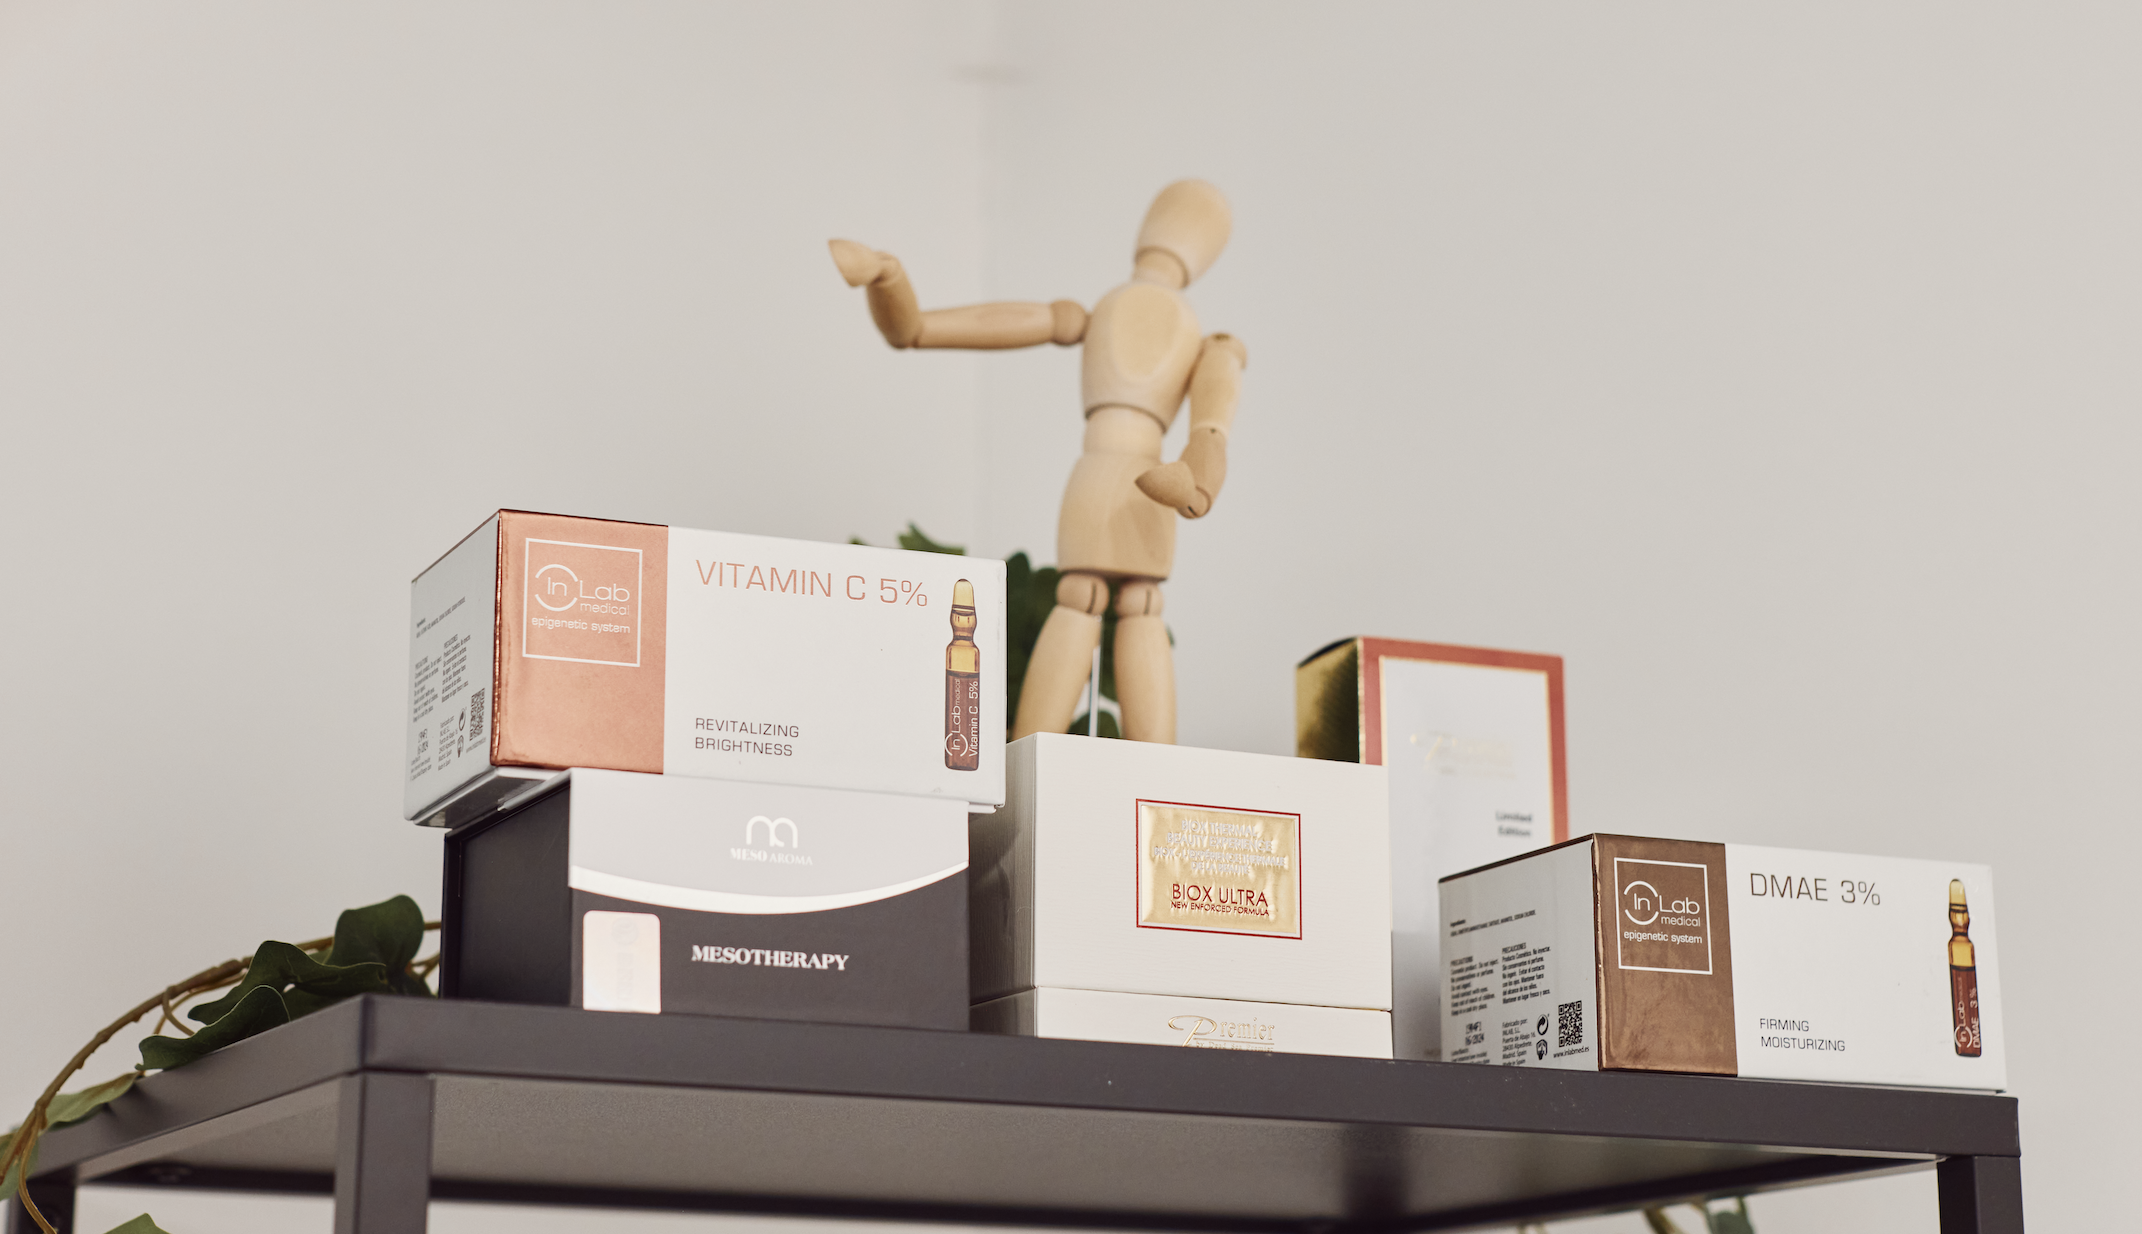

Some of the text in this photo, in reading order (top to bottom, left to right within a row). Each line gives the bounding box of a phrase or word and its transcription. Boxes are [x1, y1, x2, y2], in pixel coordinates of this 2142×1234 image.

[548, 577, 630, 602] In Lab
[696, 560, 928, 606] VITAMIN C 5%
[580, 602, 630, 615] medical
[532, 616, 630, 634] epigenetic system
[696, 717, 800, 738] REVITALIZING
[968, 680, 978, 757] Vitamin C 5%
[695, 737, 792, 756] BRIGHTNESS
[1182, 820, 1258, 836] BIOX THERMAL
[1167, 832, 1272, 852] BEAUTY EXPERIENCE
[730, 848, 813, 866] MESO AROMA
[1172, 884, 1268, 907] BIOX ULTRA
[1750, 872, 1880, 906] DMAE 3%
[1171, 901, 1269, 916] NEW ENFORCED FORMULA
[1634, 893, 1700, 914] In Lab
[1660, 916, 1700, 927] medical
[1624, 930, 1702, 944] epigenetic system
[691, 944, 849, 971] MESOTHERAPY
[1168, 1015, 1275, 1046] Premier
[1502, 1020, 1519, 1028] Fabricado
[1760, 1018, 1810, 1032] FIRMING
[1971, 1017, 1980, 1048] DMAE
[1760, 1036, 1846, 1052] MOISTURIZING
